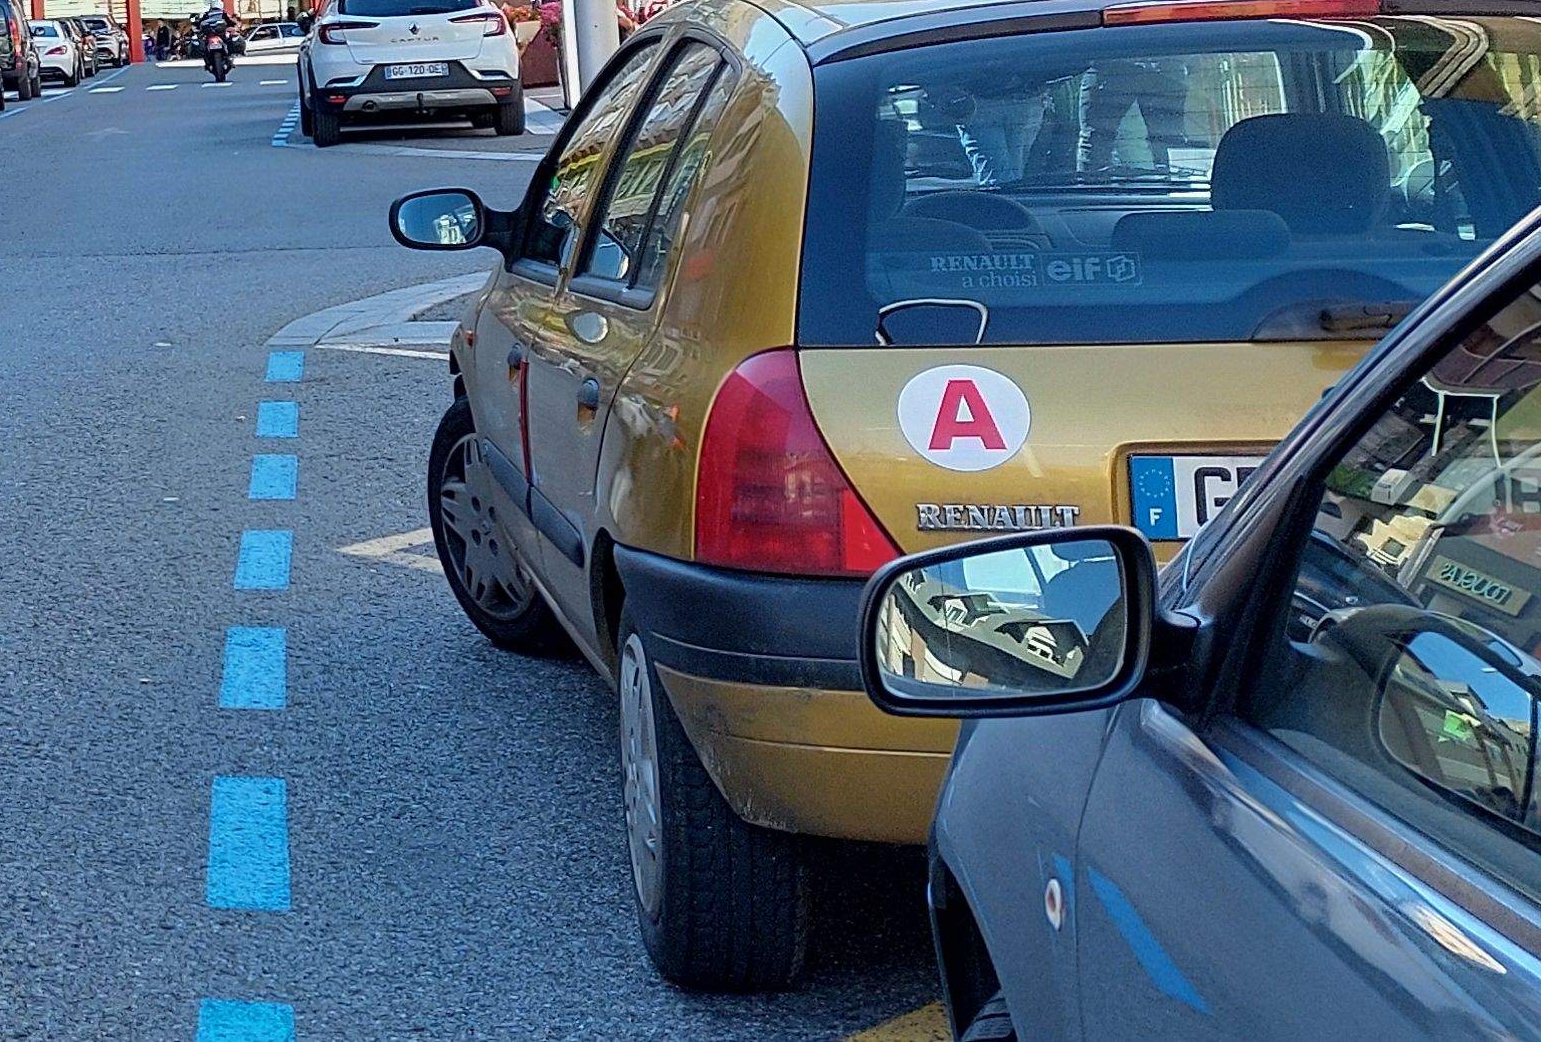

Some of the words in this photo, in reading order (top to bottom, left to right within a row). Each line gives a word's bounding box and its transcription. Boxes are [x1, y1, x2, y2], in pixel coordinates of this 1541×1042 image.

[930, 254, 1035, 272] RENAULT
[1046, 258, 1101, 281] elf
[962, 276, 974, 288] a
[979, 271, 1038, 288] choisi
[927, 379, 1008, 451] A
[917, 503, 1080, 532] RENAULT
[1149, 508, 1163, 526] F
